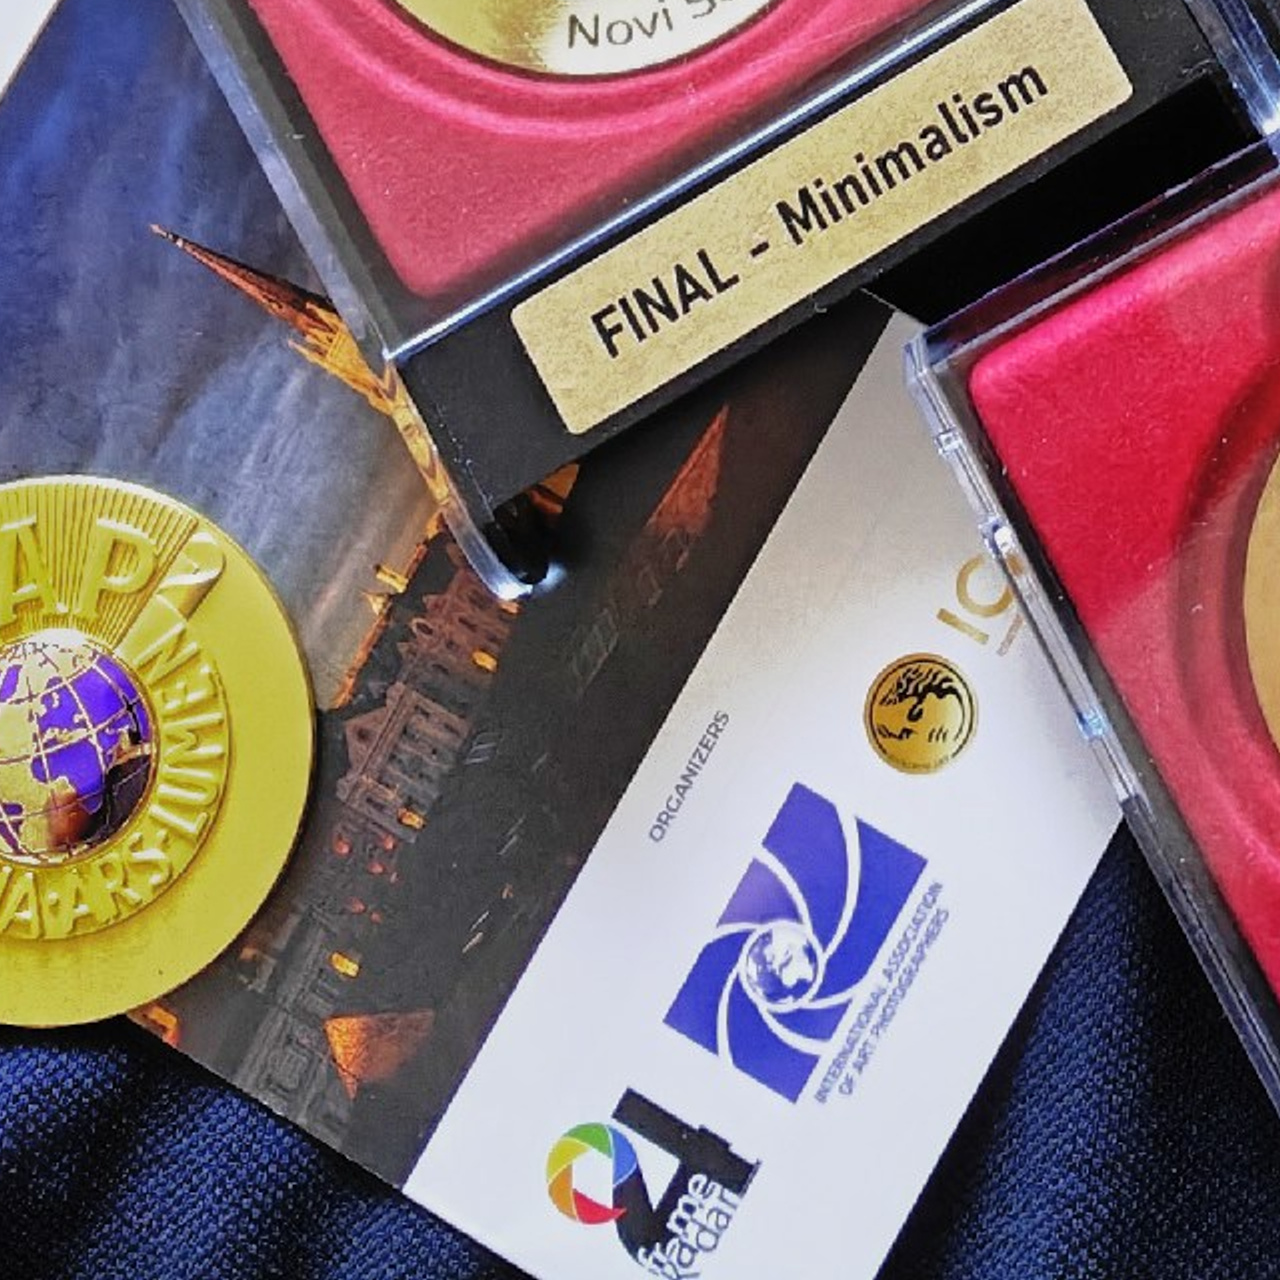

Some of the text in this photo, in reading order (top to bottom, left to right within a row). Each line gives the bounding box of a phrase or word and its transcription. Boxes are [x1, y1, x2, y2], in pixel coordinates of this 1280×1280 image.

[589, 63, 1051, 361] FINAL - Minimalism
[648, 711, 731, 844] ORGANIZERS
